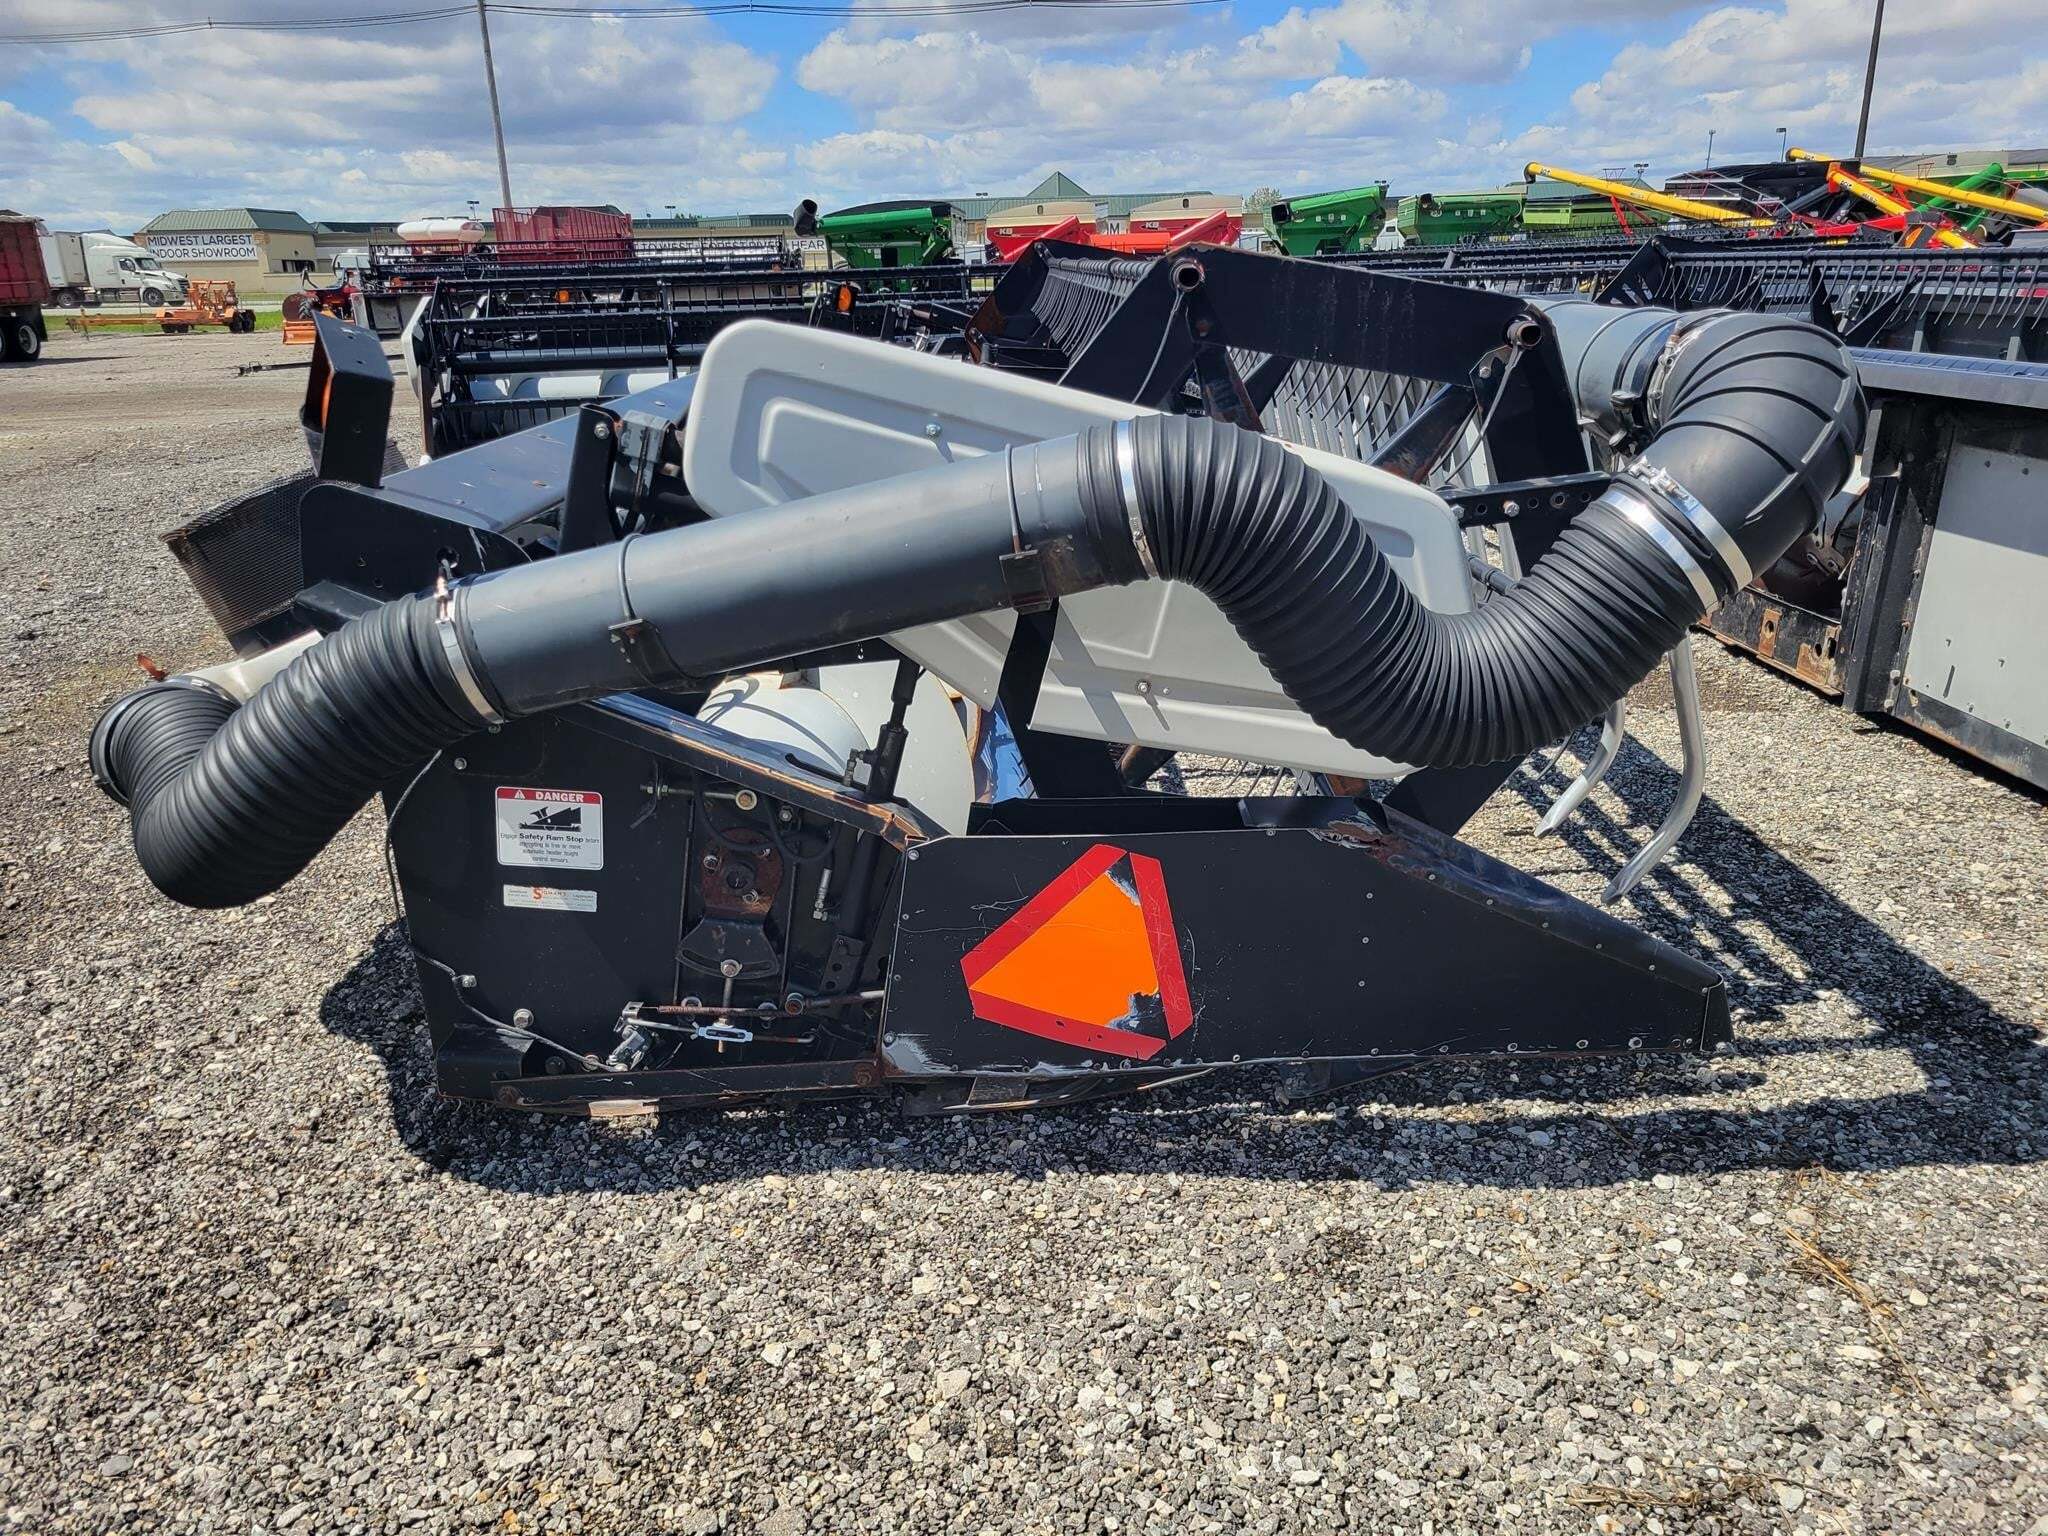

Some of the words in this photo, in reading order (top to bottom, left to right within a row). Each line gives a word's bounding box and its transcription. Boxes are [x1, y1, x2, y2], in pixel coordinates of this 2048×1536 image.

[147, 235, 199, 246] MIDWEST
[202, 234, 252, 245] LARGEST
[191, 247, 256, 258] SHOWROOM
[535, 791, 584, 803] DANGER
[520, 833, 543, 842] Safety
[566, 835, 584, 843] Stop
